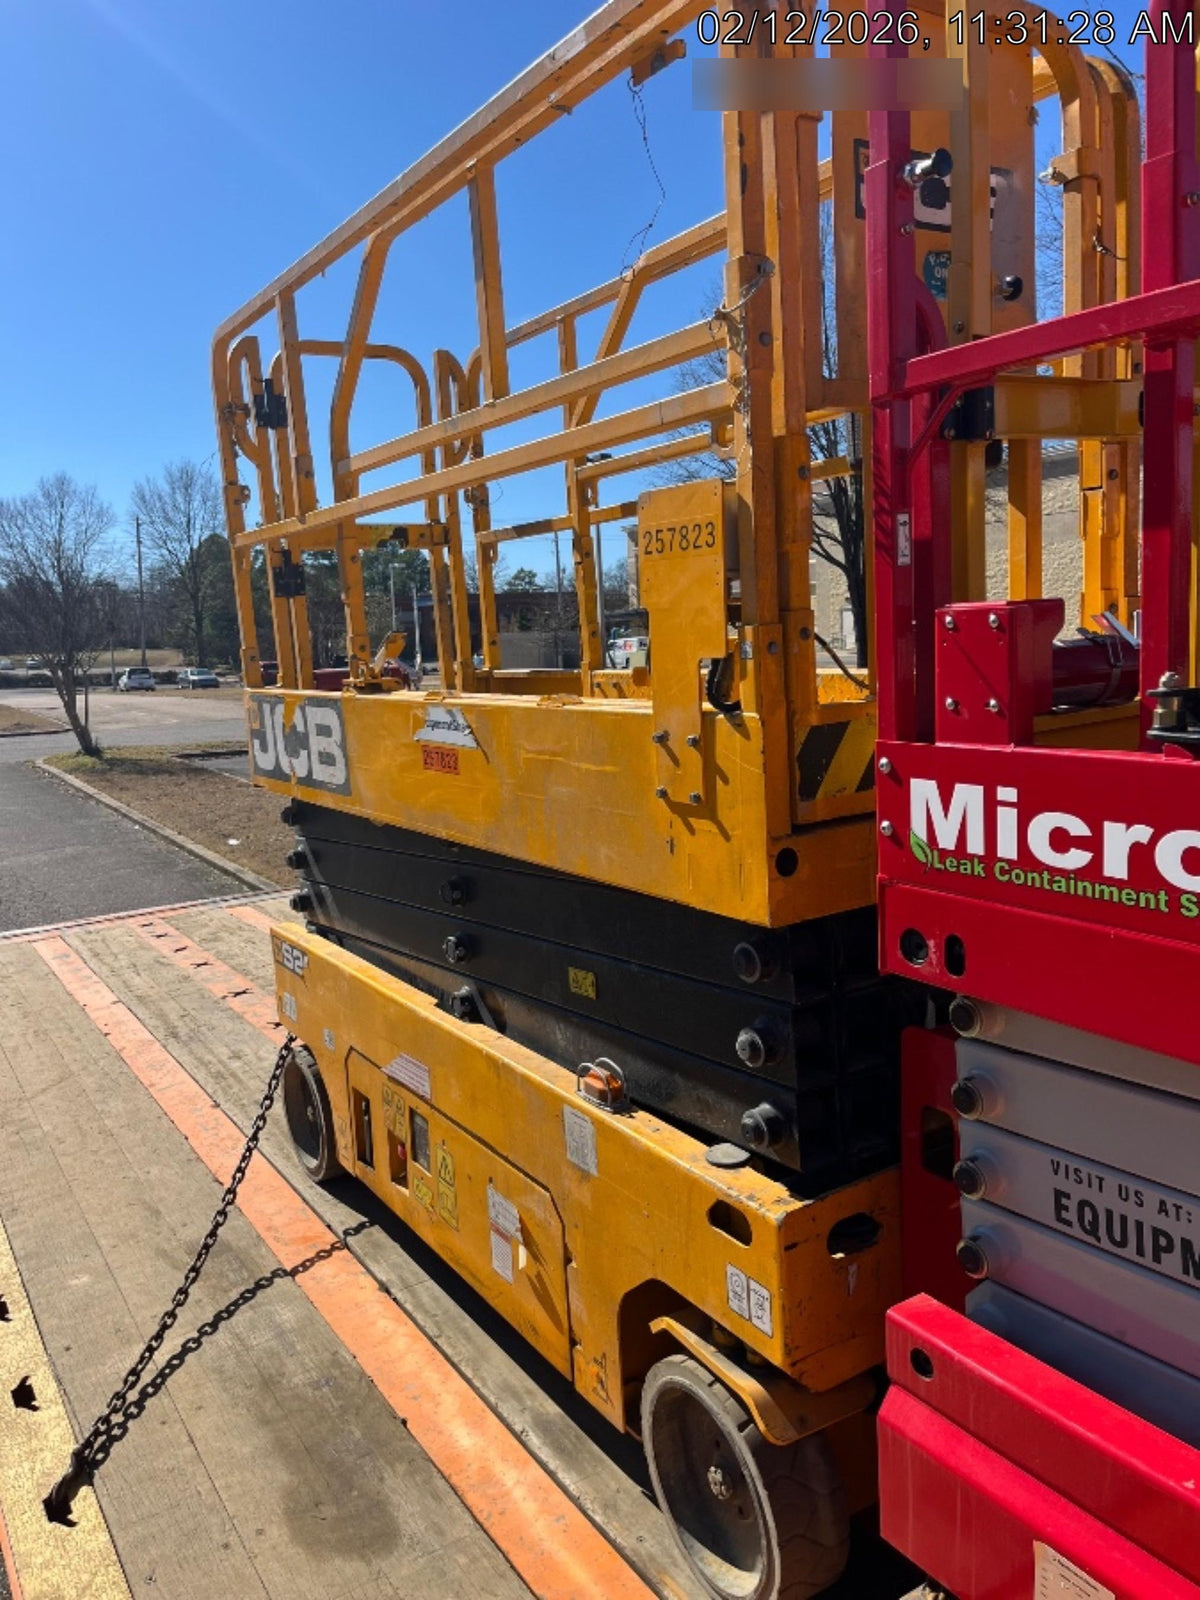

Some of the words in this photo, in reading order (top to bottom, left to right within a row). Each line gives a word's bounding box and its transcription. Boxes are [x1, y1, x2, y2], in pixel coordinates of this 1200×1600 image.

[642, 521, 716, 556] 257823
[252, 702, 348, 786] JCB
[932, 847, 986, 878] Leak
[993, 861, 1170, 913] Containment
[1050, 1158, 1105, 1194] VISIT
[1117, 1183, 1145, 1208] US
[1157, 1198, 1193, 1224] AT:
